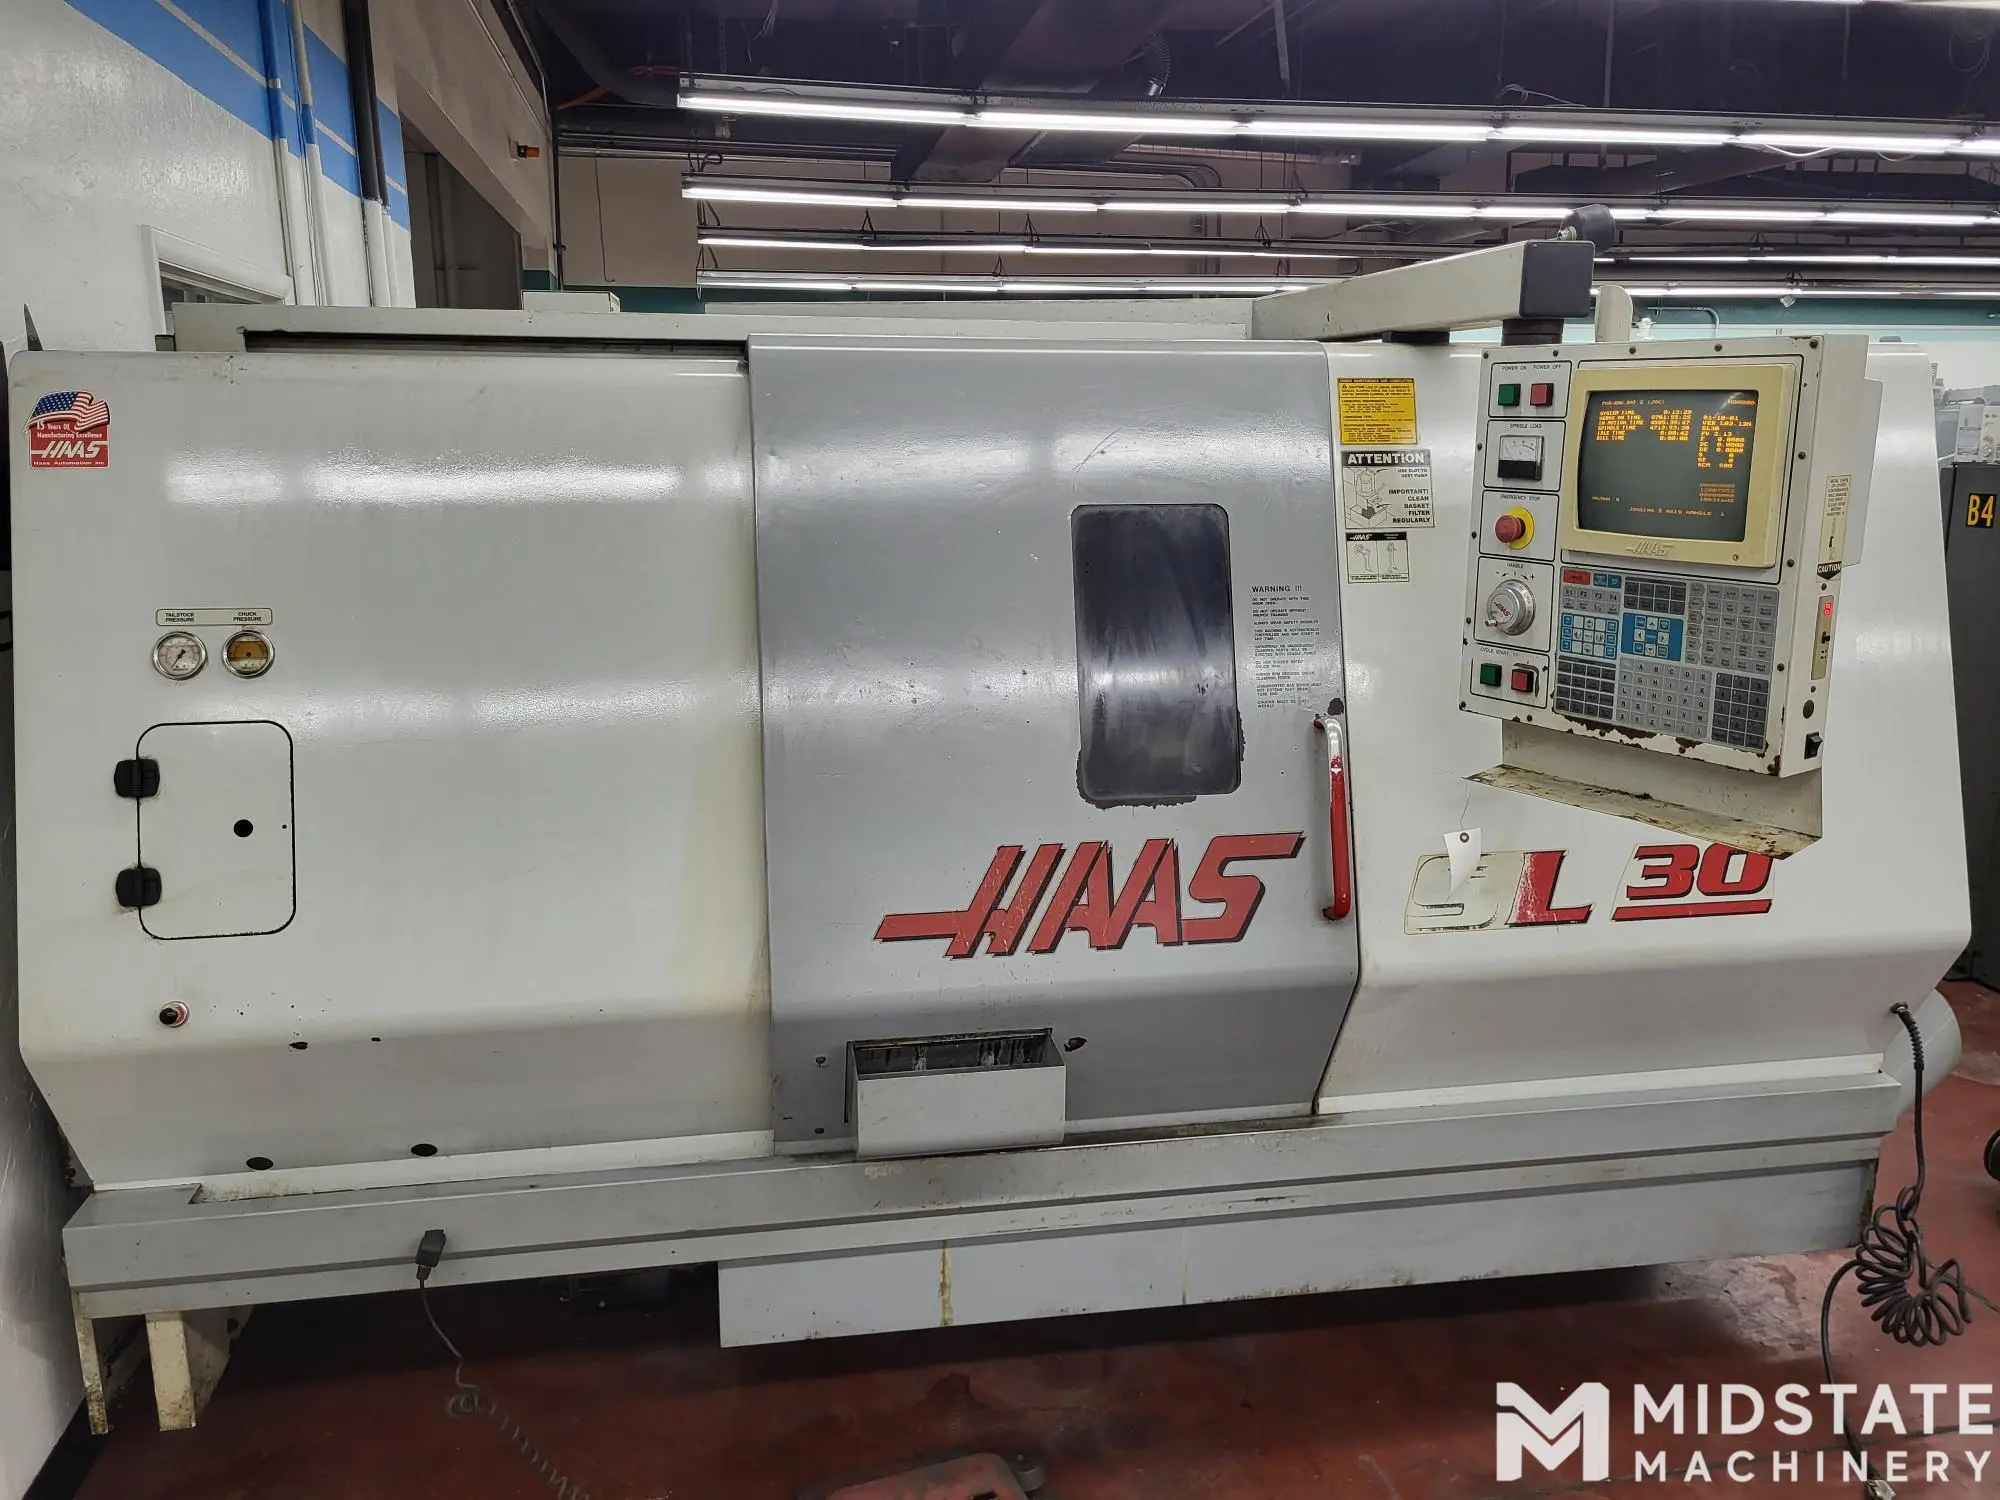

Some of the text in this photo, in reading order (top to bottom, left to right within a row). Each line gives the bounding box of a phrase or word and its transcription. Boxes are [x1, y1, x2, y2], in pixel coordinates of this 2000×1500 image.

[32, 441, 109, 458] HAAS
[1347, 452, 1424, 464] ATTENTION
[1967, 494, 1994, 527] B4
[1818, 564, 1841, 574] CAUTION
[1626, 843, 1773, 899] 30
[874, 831, 1306, 960] HAAS
